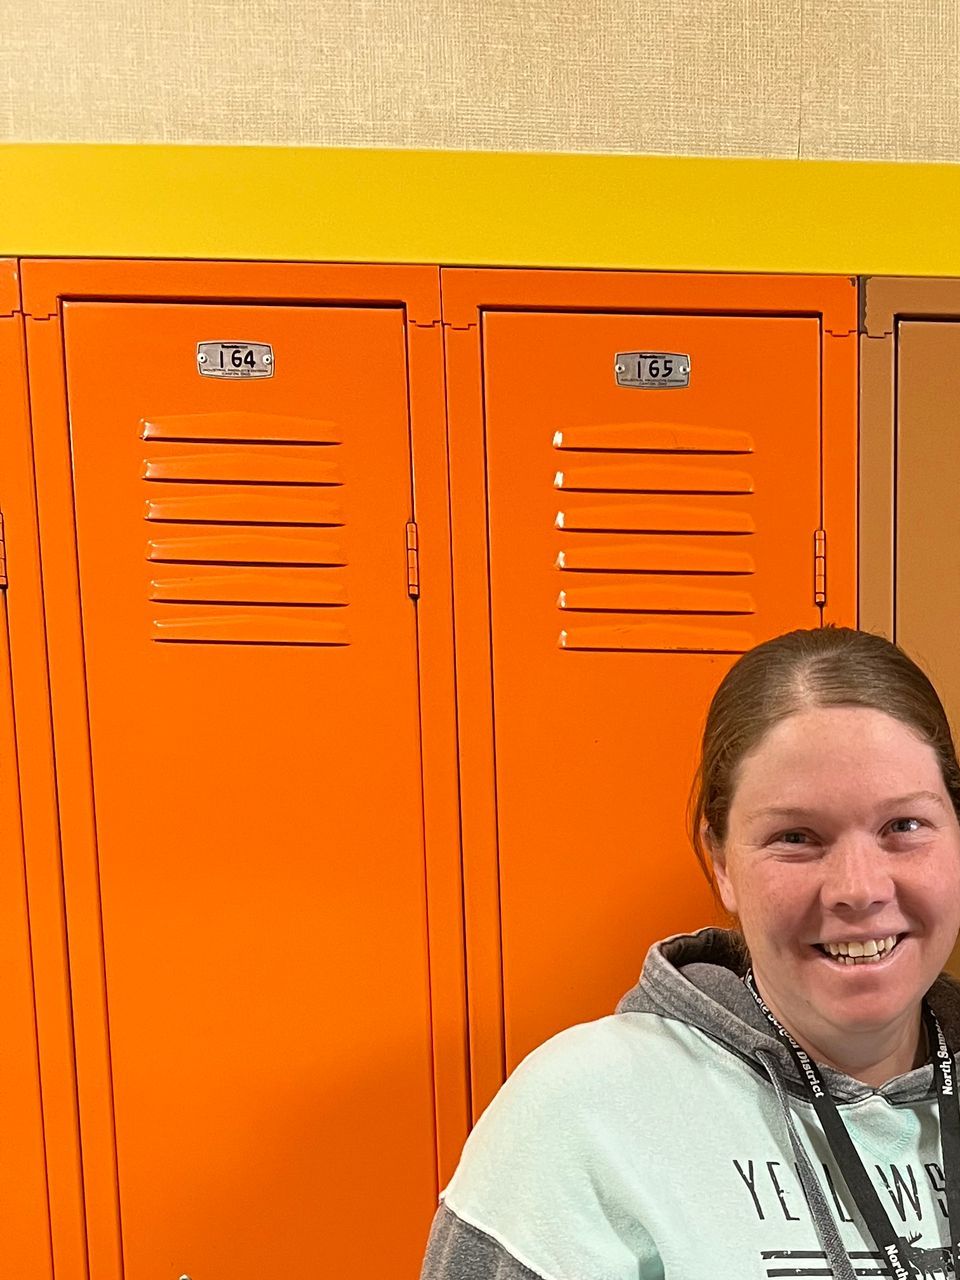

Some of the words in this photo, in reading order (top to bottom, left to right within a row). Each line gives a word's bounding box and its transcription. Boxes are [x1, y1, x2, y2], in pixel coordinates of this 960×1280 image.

[220, 350, 256, 368] 164
[638, 360, 673, 378] 165
[797, 1049, 825, 1098] District
[940, 1057, 954, 1096] North
